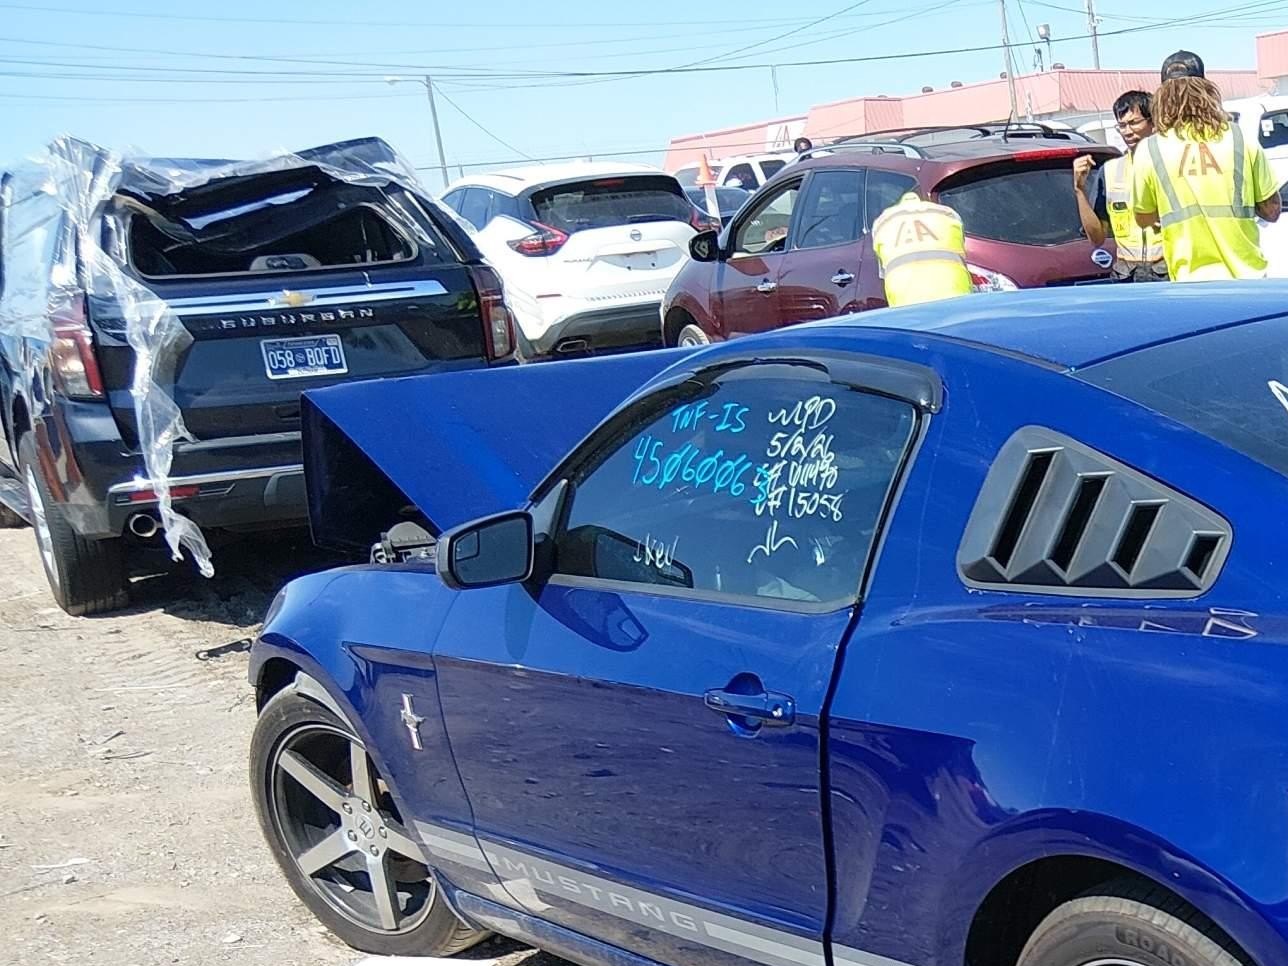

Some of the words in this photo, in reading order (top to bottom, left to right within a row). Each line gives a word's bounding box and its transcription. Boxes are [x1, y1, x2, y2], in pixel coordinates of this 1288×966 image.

[221, 308, 374, 330] SUBURBAN
[268, 350, 296, 370] 058
[503, 856, 699, 933] MUSTANG
